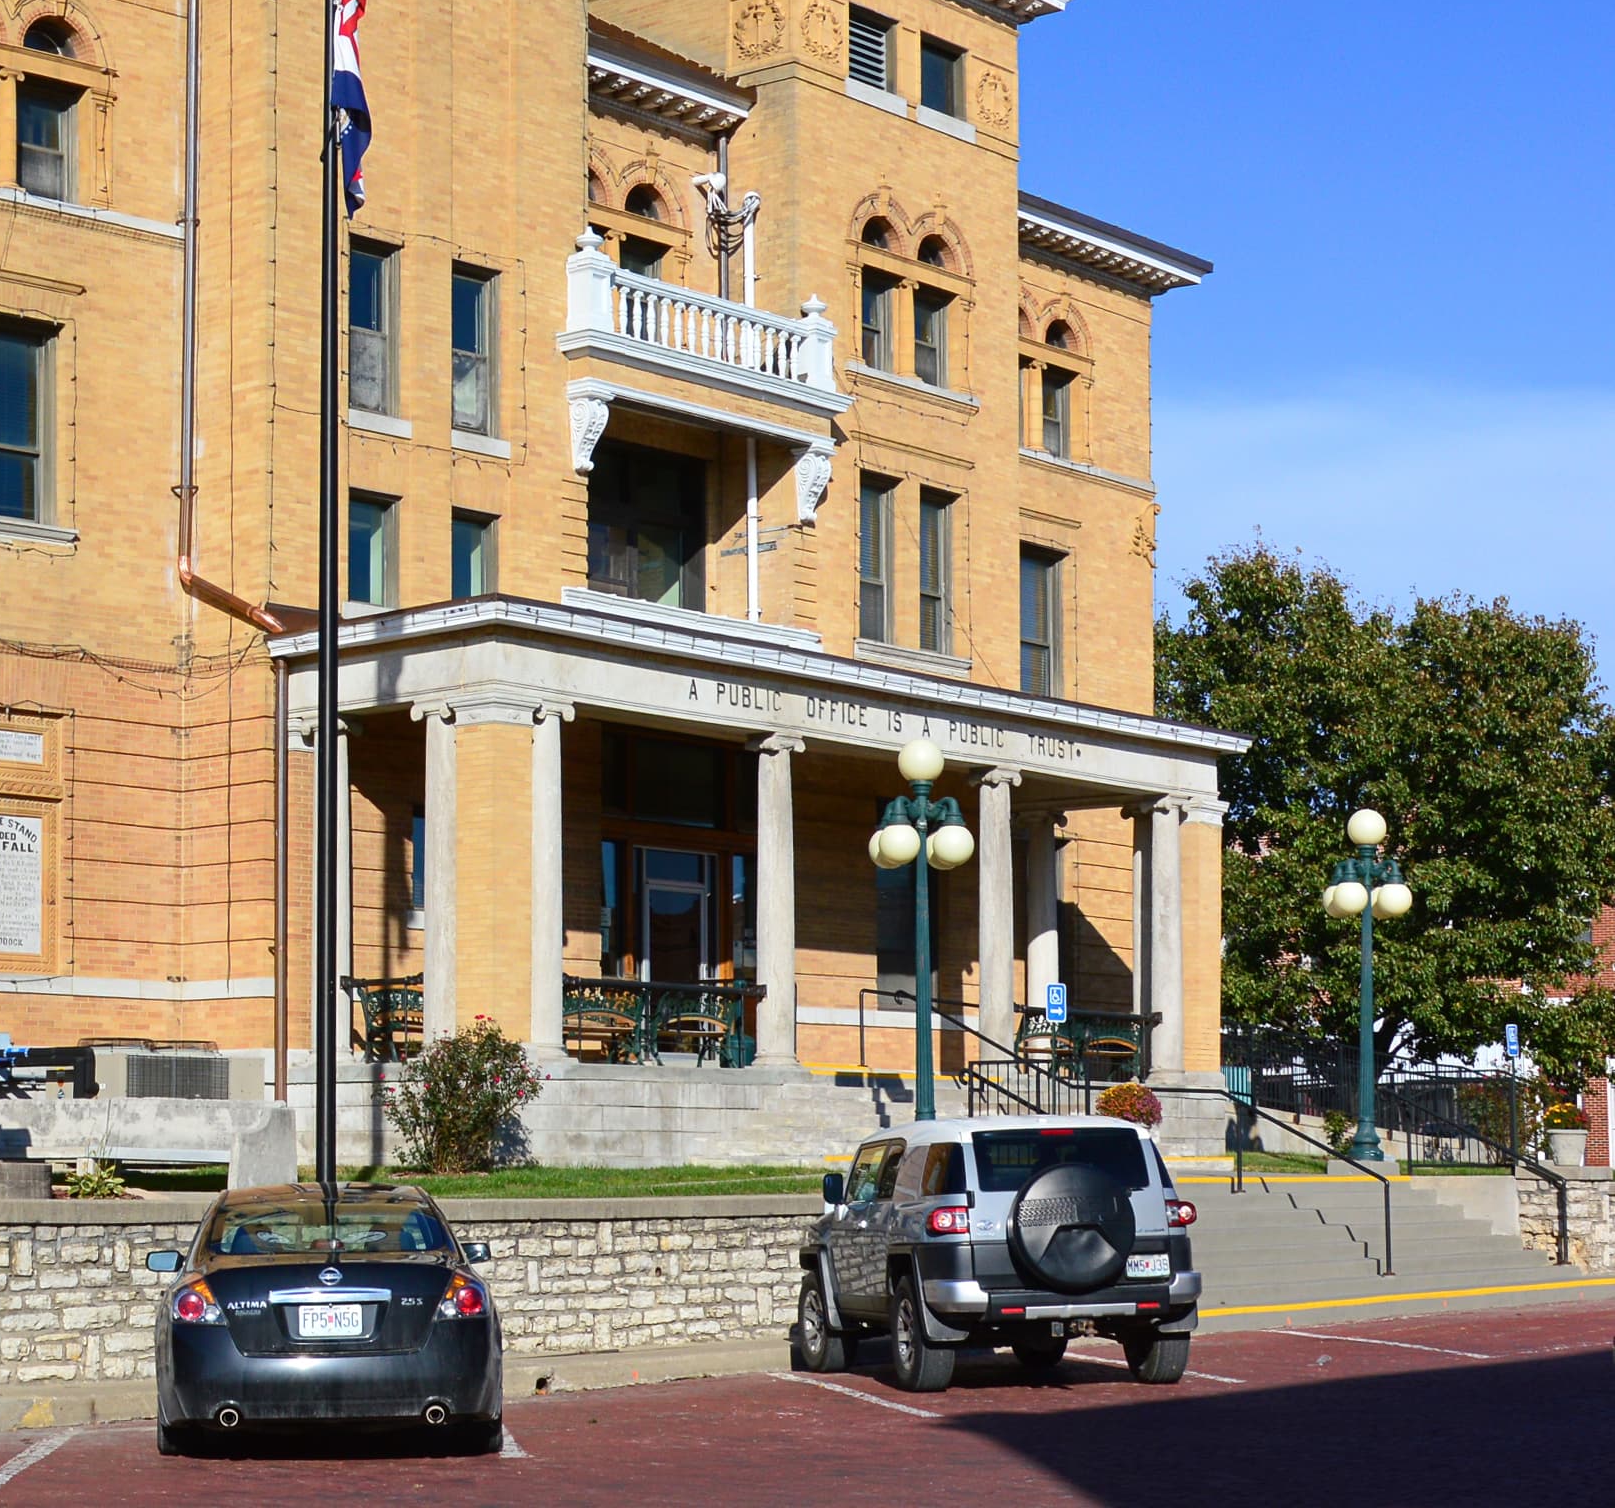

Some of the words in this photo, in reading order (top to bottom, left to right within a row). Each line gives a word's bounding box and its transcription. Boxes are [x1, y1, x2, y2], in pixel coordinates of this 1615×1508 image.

[689, 679, 698, 701] A
[716, 683, 782, 712] PUBLIC
[807, 696, 868, 727] OFFICE
[888, 710, 902, 732] IS
[922, 716, 930, 737] A
[949, 721, 1005, 748] PUBLIC
[8, 819, 38, 843] STAND
[227, 1301, 267, 1310] ALTIMA
